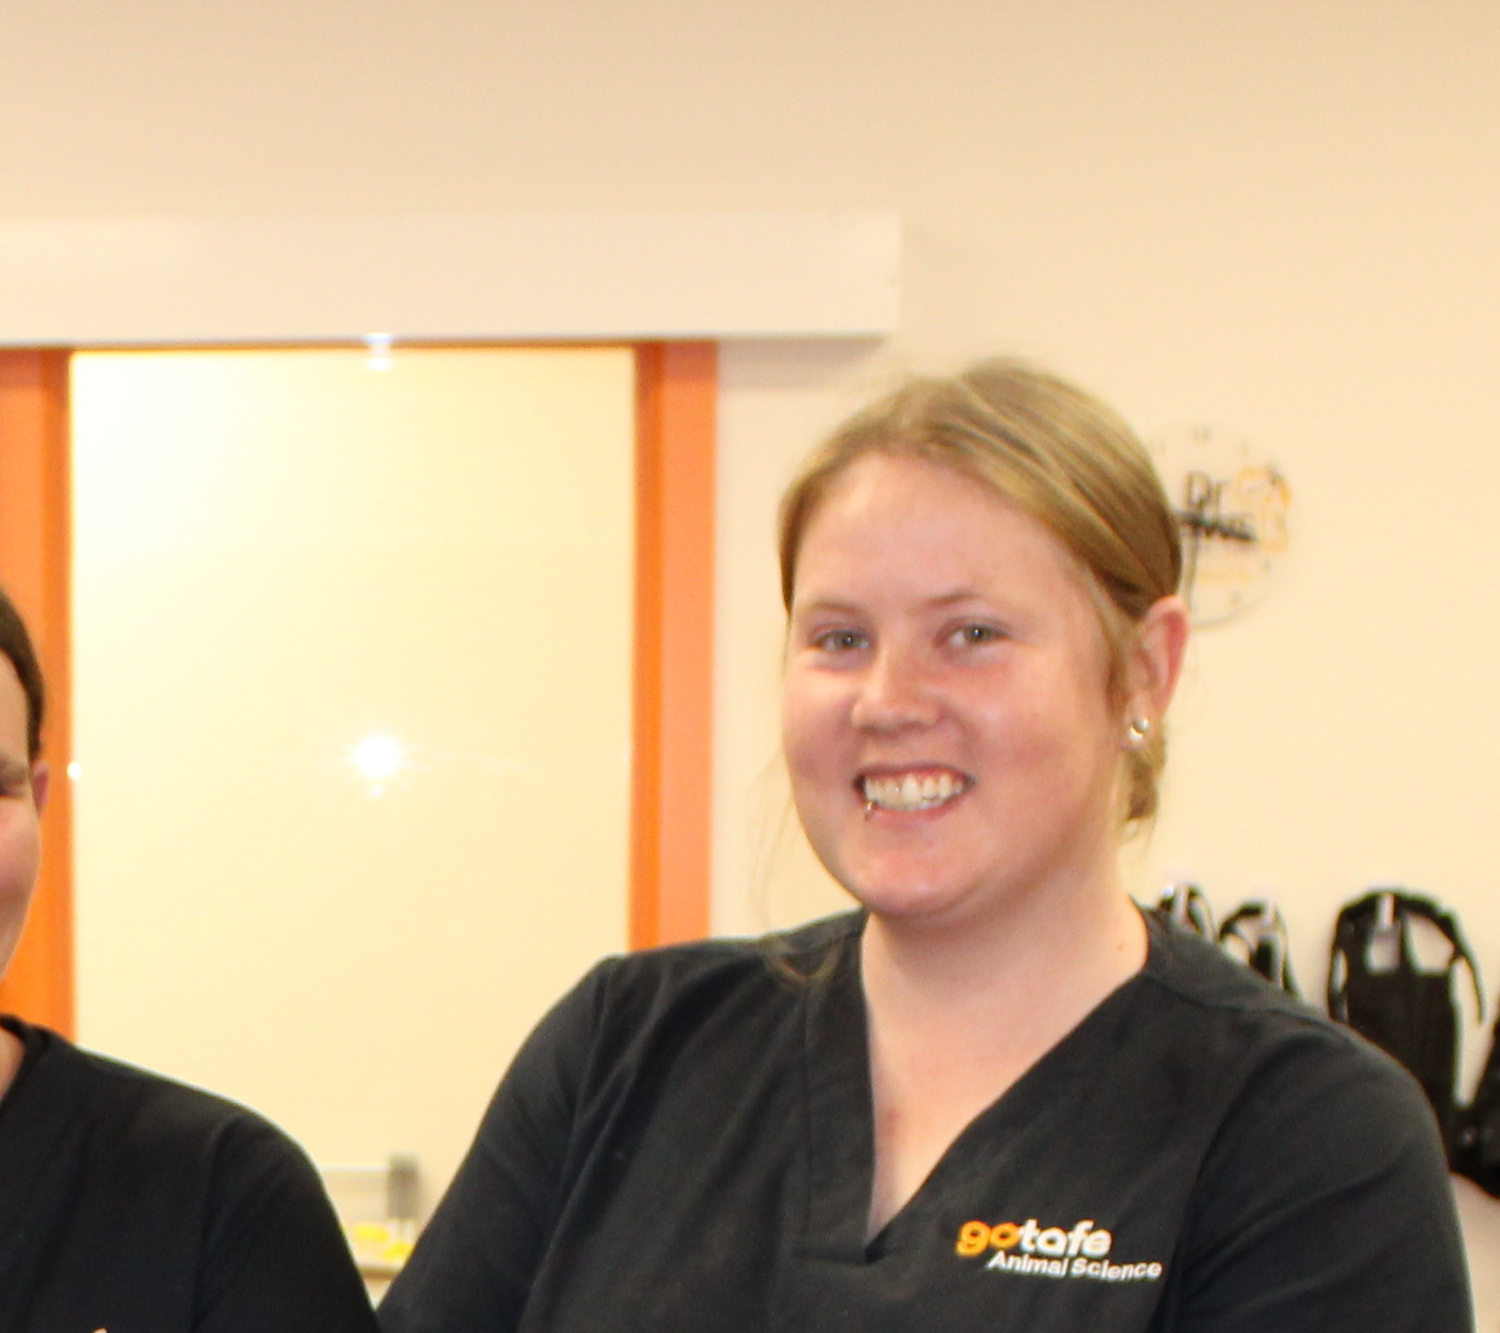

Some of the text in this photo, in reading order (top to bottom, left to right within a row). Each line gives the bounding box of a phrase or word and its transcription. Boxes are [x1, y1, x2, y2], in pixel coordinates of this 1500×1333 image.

[956, 1218, 1114, 1257] gotafe
[986, 1250, 1163, 1281] Animal Science
